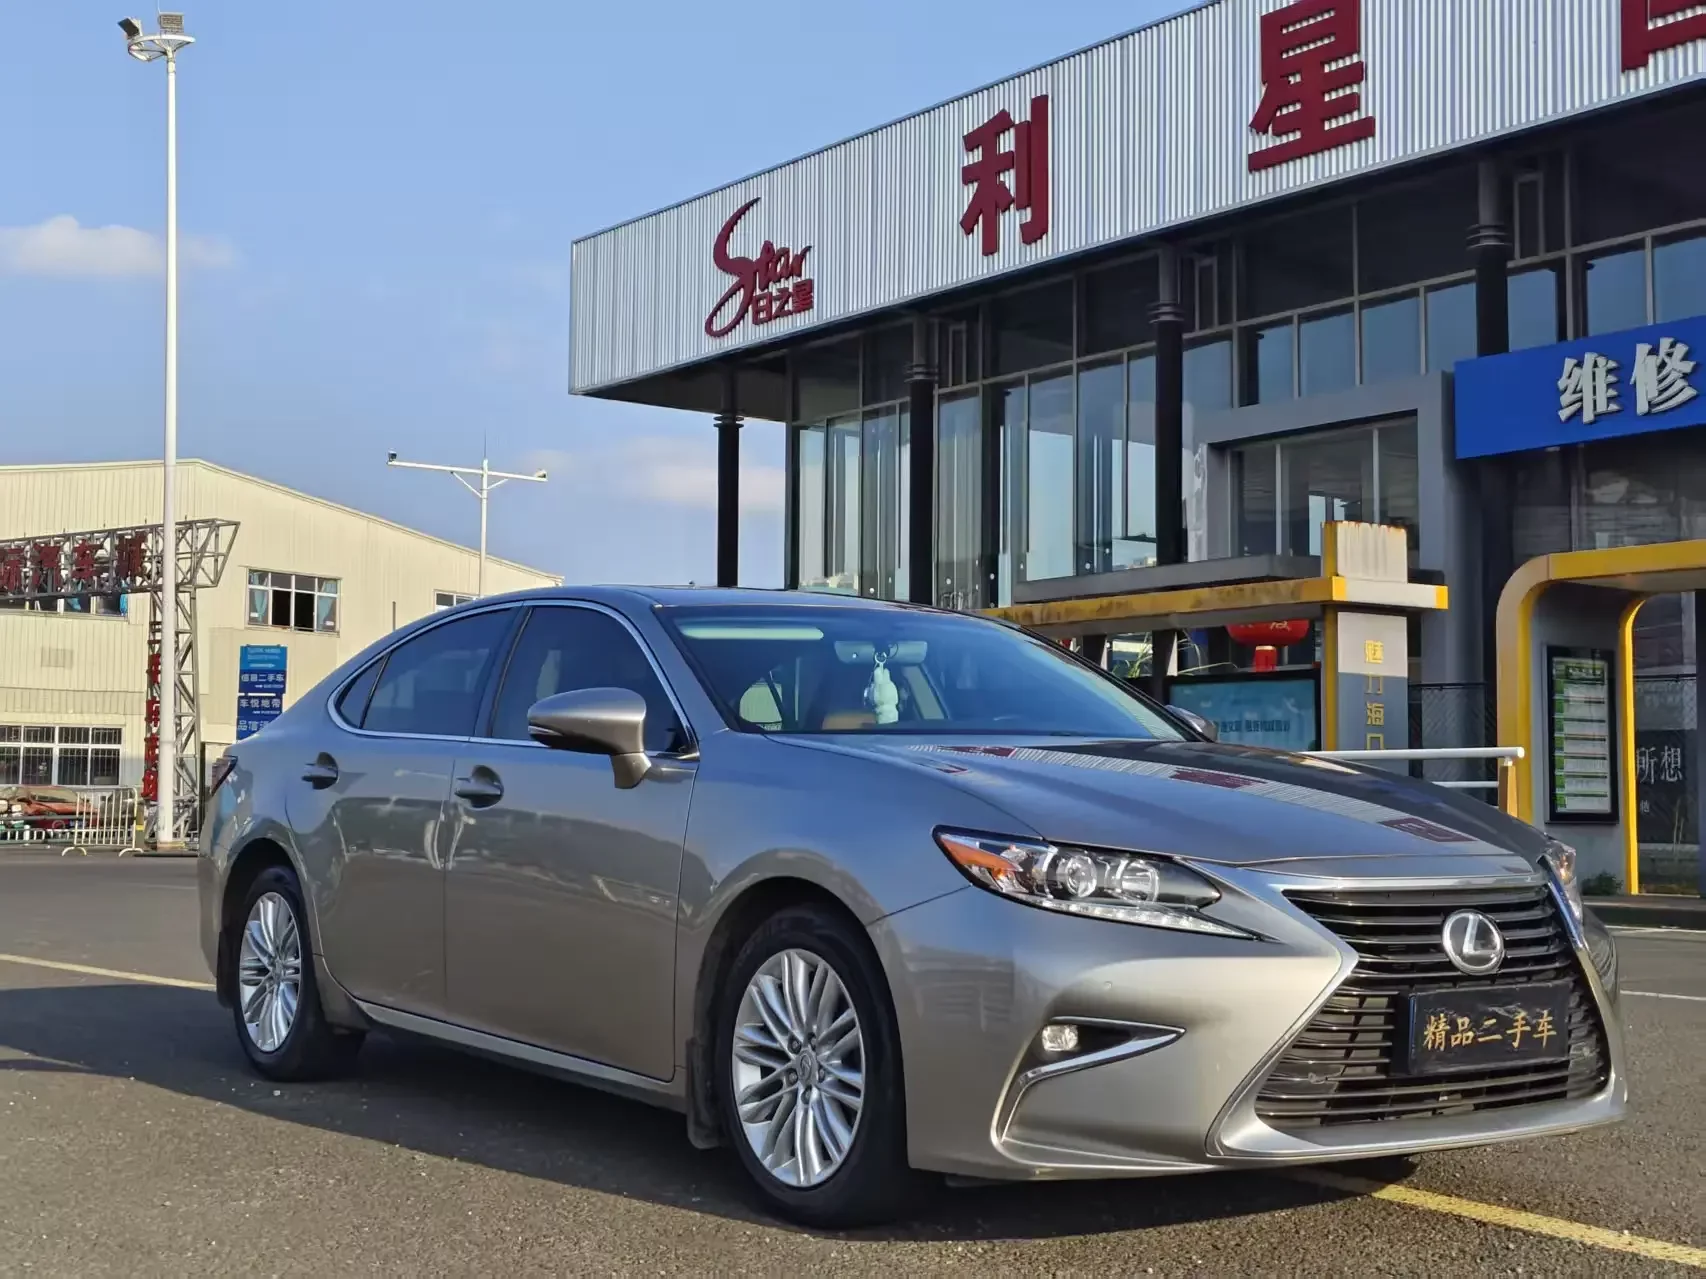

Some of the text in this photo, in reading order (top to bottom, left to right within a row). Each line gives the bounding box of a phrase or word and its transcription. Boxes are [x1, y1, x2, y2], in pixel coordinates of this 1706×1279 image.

[705, 197, 813, 338] Star
[1557, 336, 1699, 424] 维修
[1423, 1009, 1557, 1052] 精品二手车
